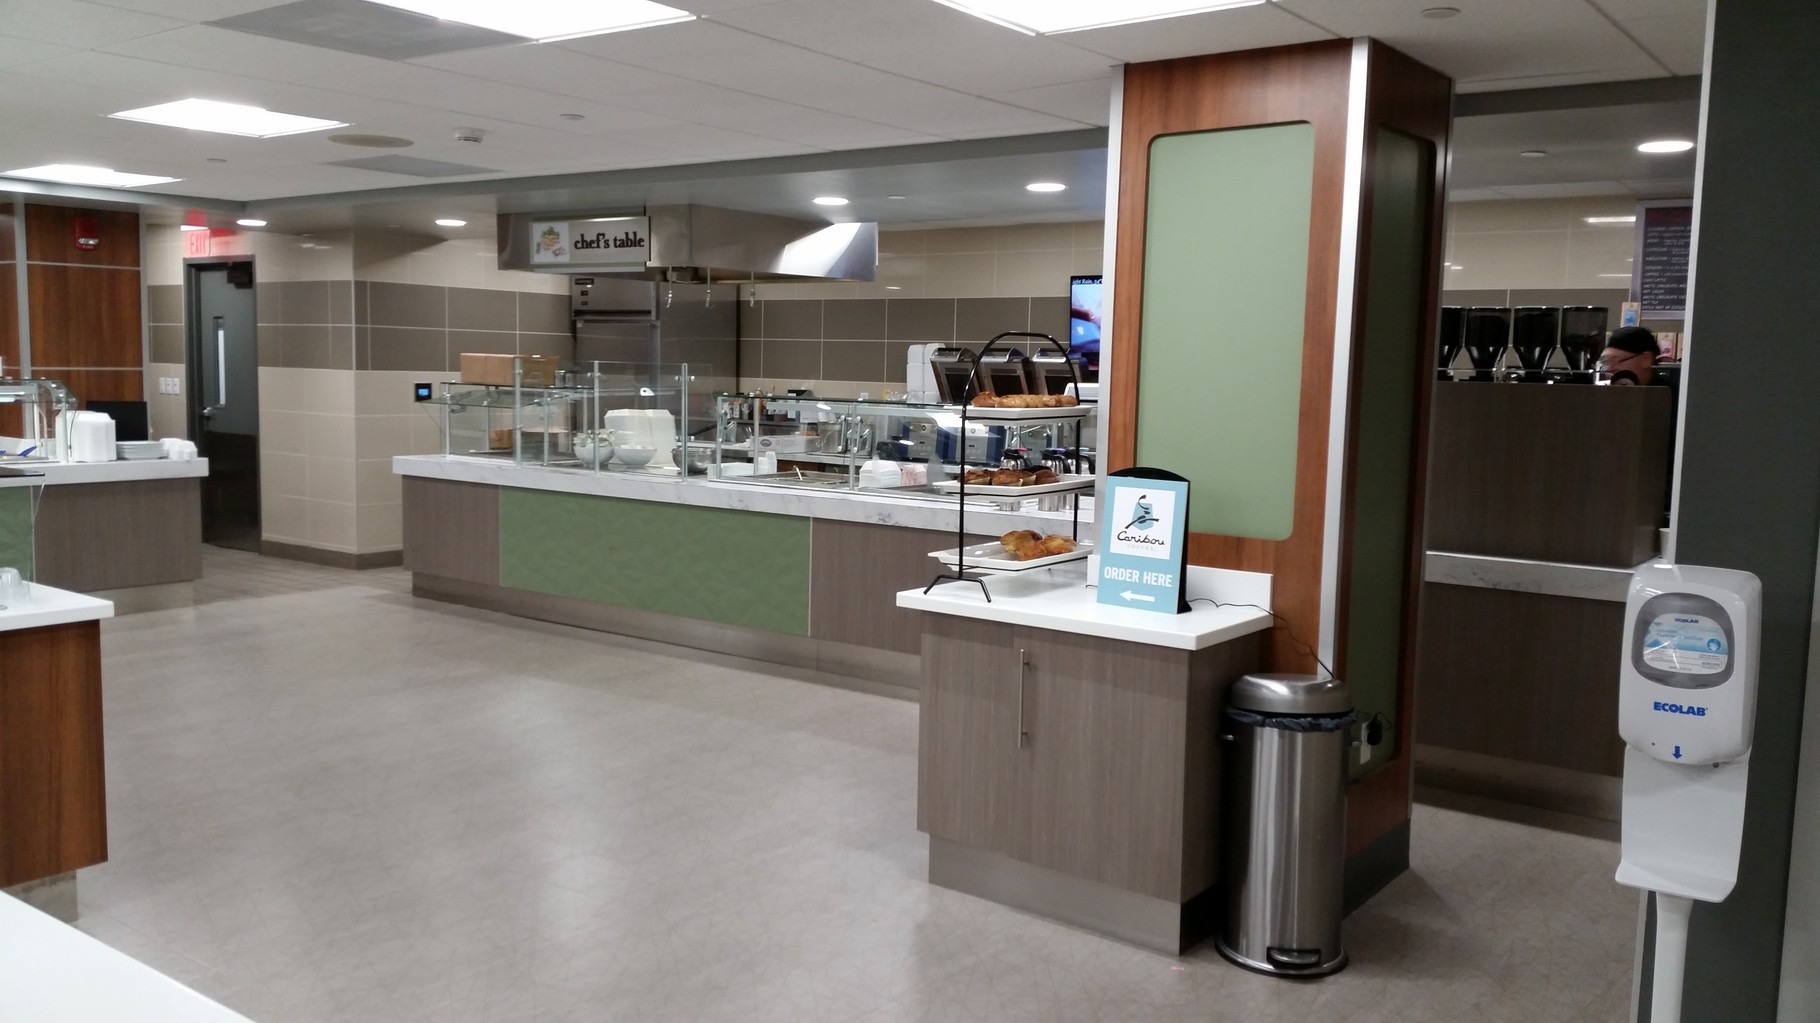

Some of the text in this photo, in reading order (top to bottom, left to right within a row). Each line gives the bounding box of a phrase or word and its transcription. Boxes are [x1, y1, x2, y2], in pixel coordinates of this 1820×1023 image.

[189, 233, 207, 255] EXIT
[574, 231, 645, 250] chef's table
[1117, 530, 1165, 545] Caribou
[1104, 566, 1173, 588] ORDER HERE
[1653, 701, 1707, 717] ECOLAB
